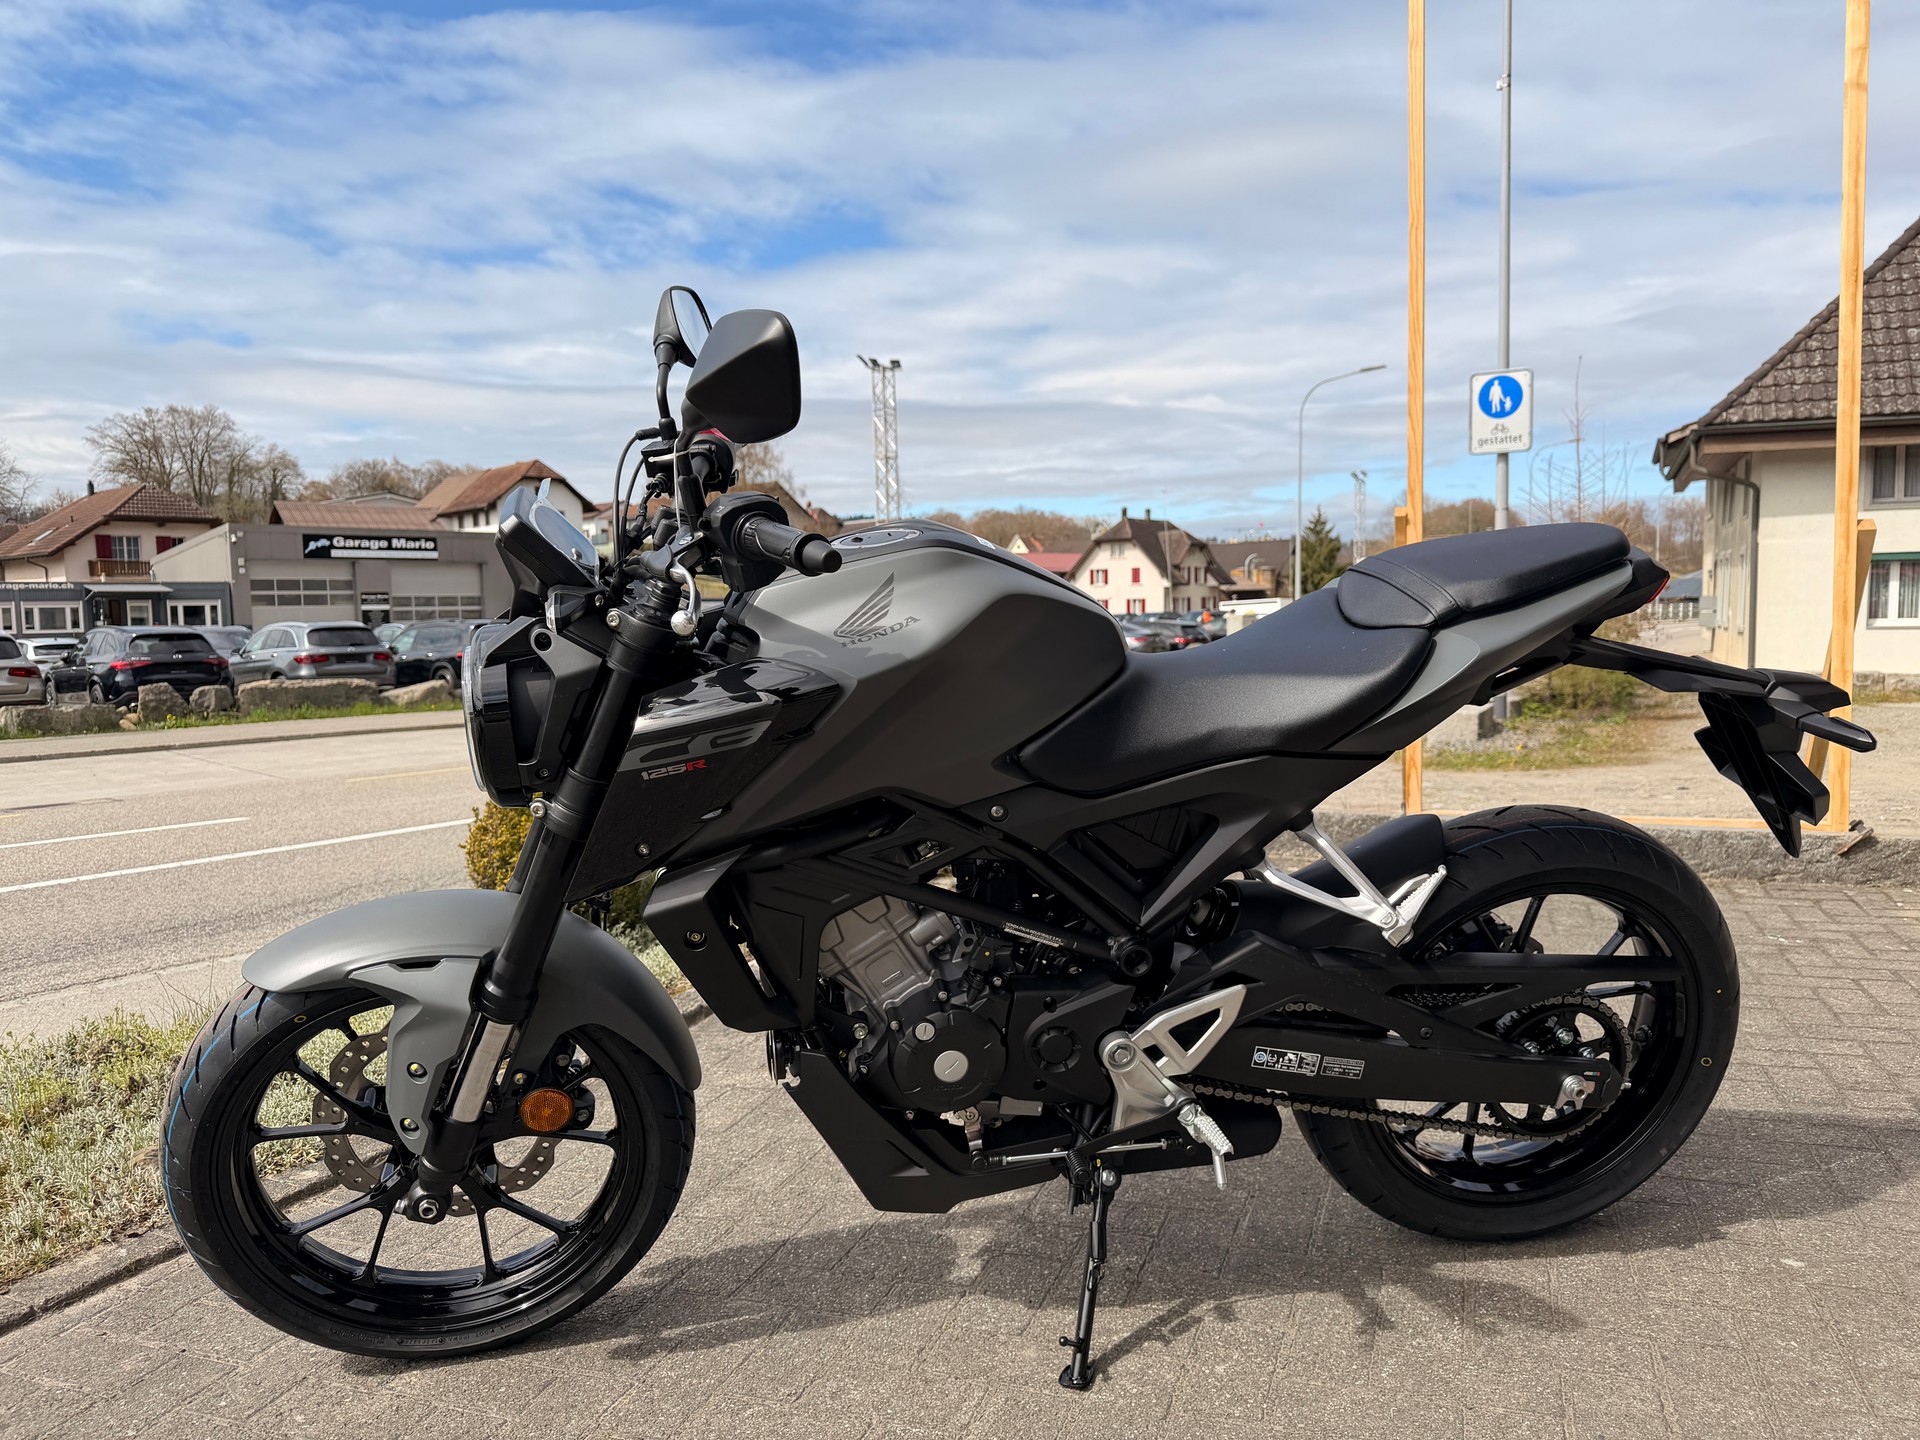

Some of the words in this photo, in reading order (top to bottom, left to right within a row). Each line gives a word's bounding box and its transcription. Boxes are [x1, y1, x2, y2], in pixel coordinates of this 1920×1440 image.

[1477, 434, 1522, 448] gestattet
[332, 536, 389, 550] Garage
[391, 537, 435, 550] Mario
[841, 615, 921, 648] HONDA
[640, 758, 708, 782] 125R
